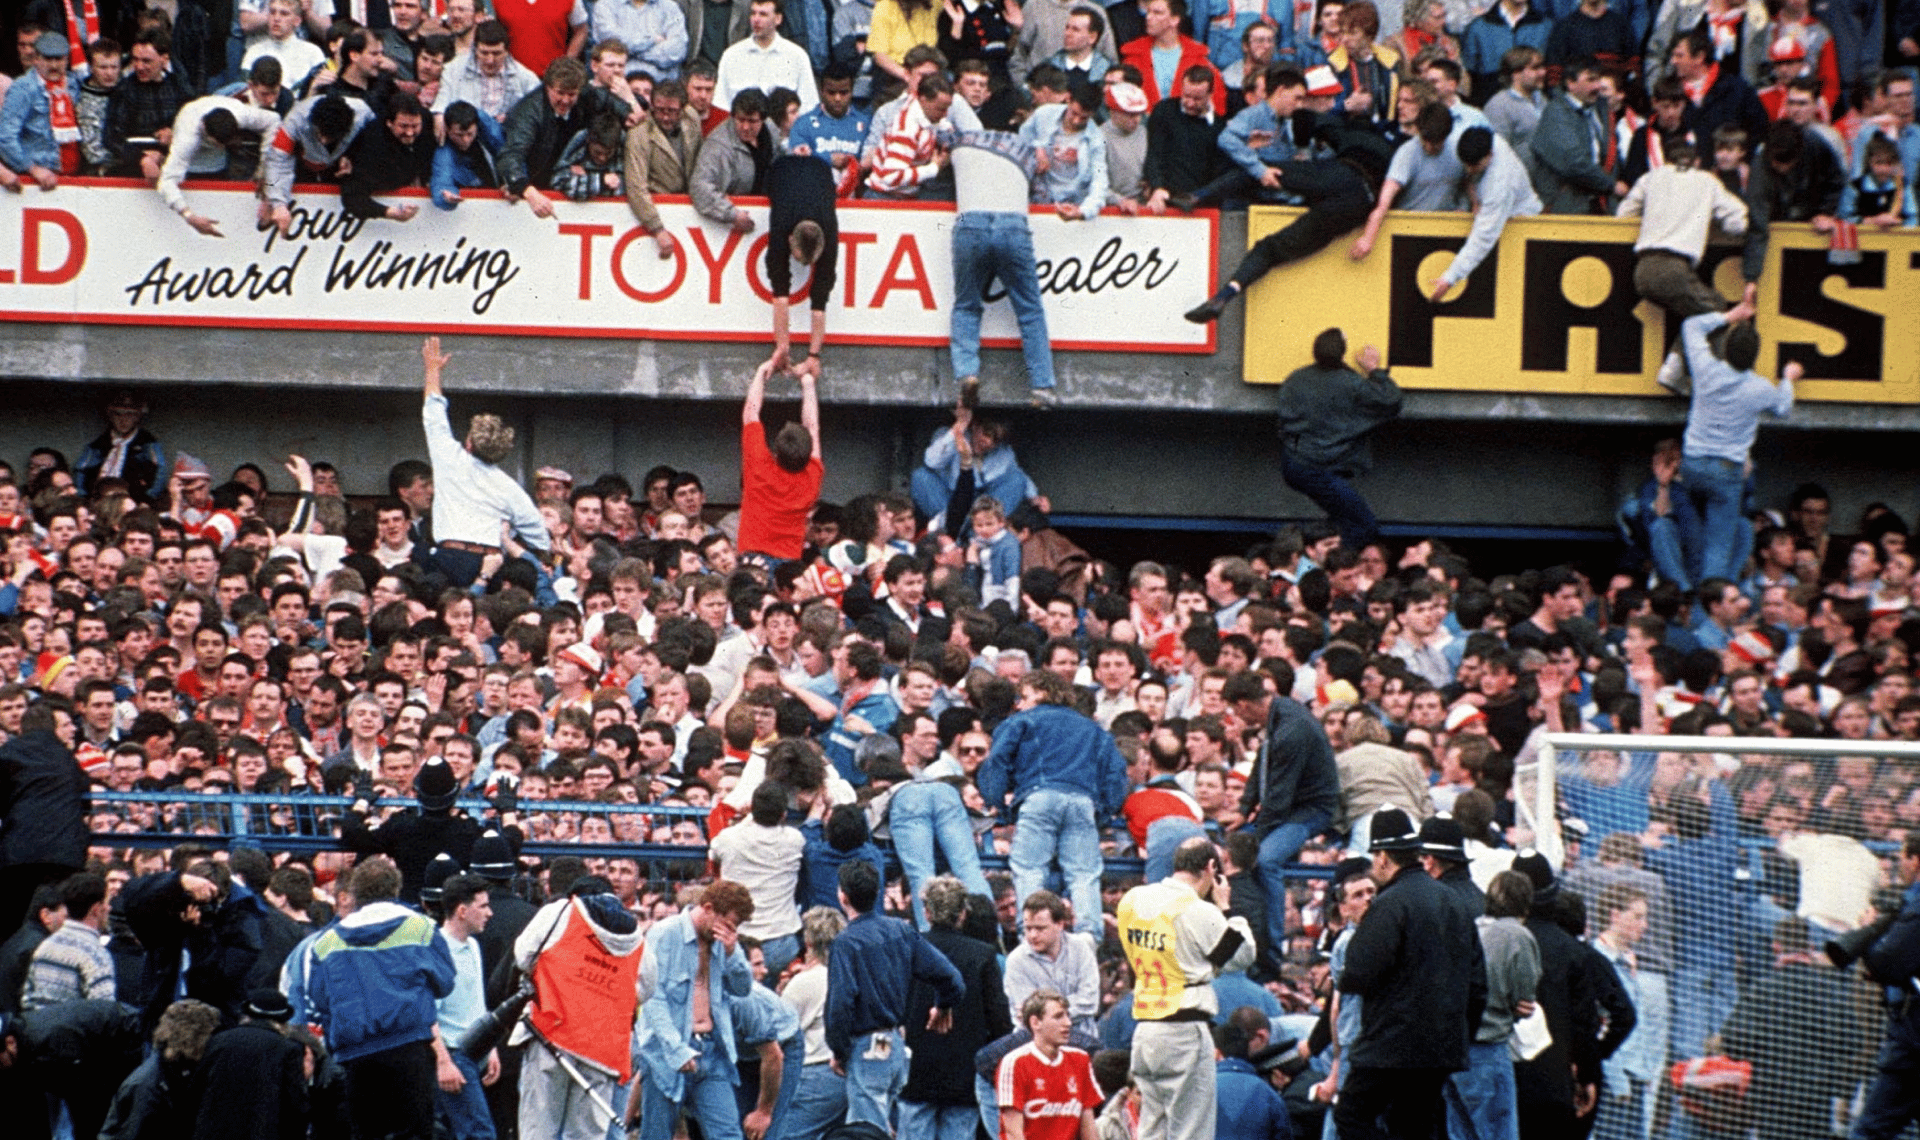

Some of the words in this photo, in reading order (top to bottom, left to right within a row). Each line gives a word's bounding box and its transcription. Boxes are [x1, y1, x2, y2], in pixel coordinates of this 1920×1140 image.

[0, 207, 88, 285] D
[125, 244, 308, 306] Award
[324, 236, 520, 314] Winning
[558, 223, 938, 311] TOYOTA
[981, 236, 1179, 303] ealer
[1127, 928, 1166, 951] PRESS
